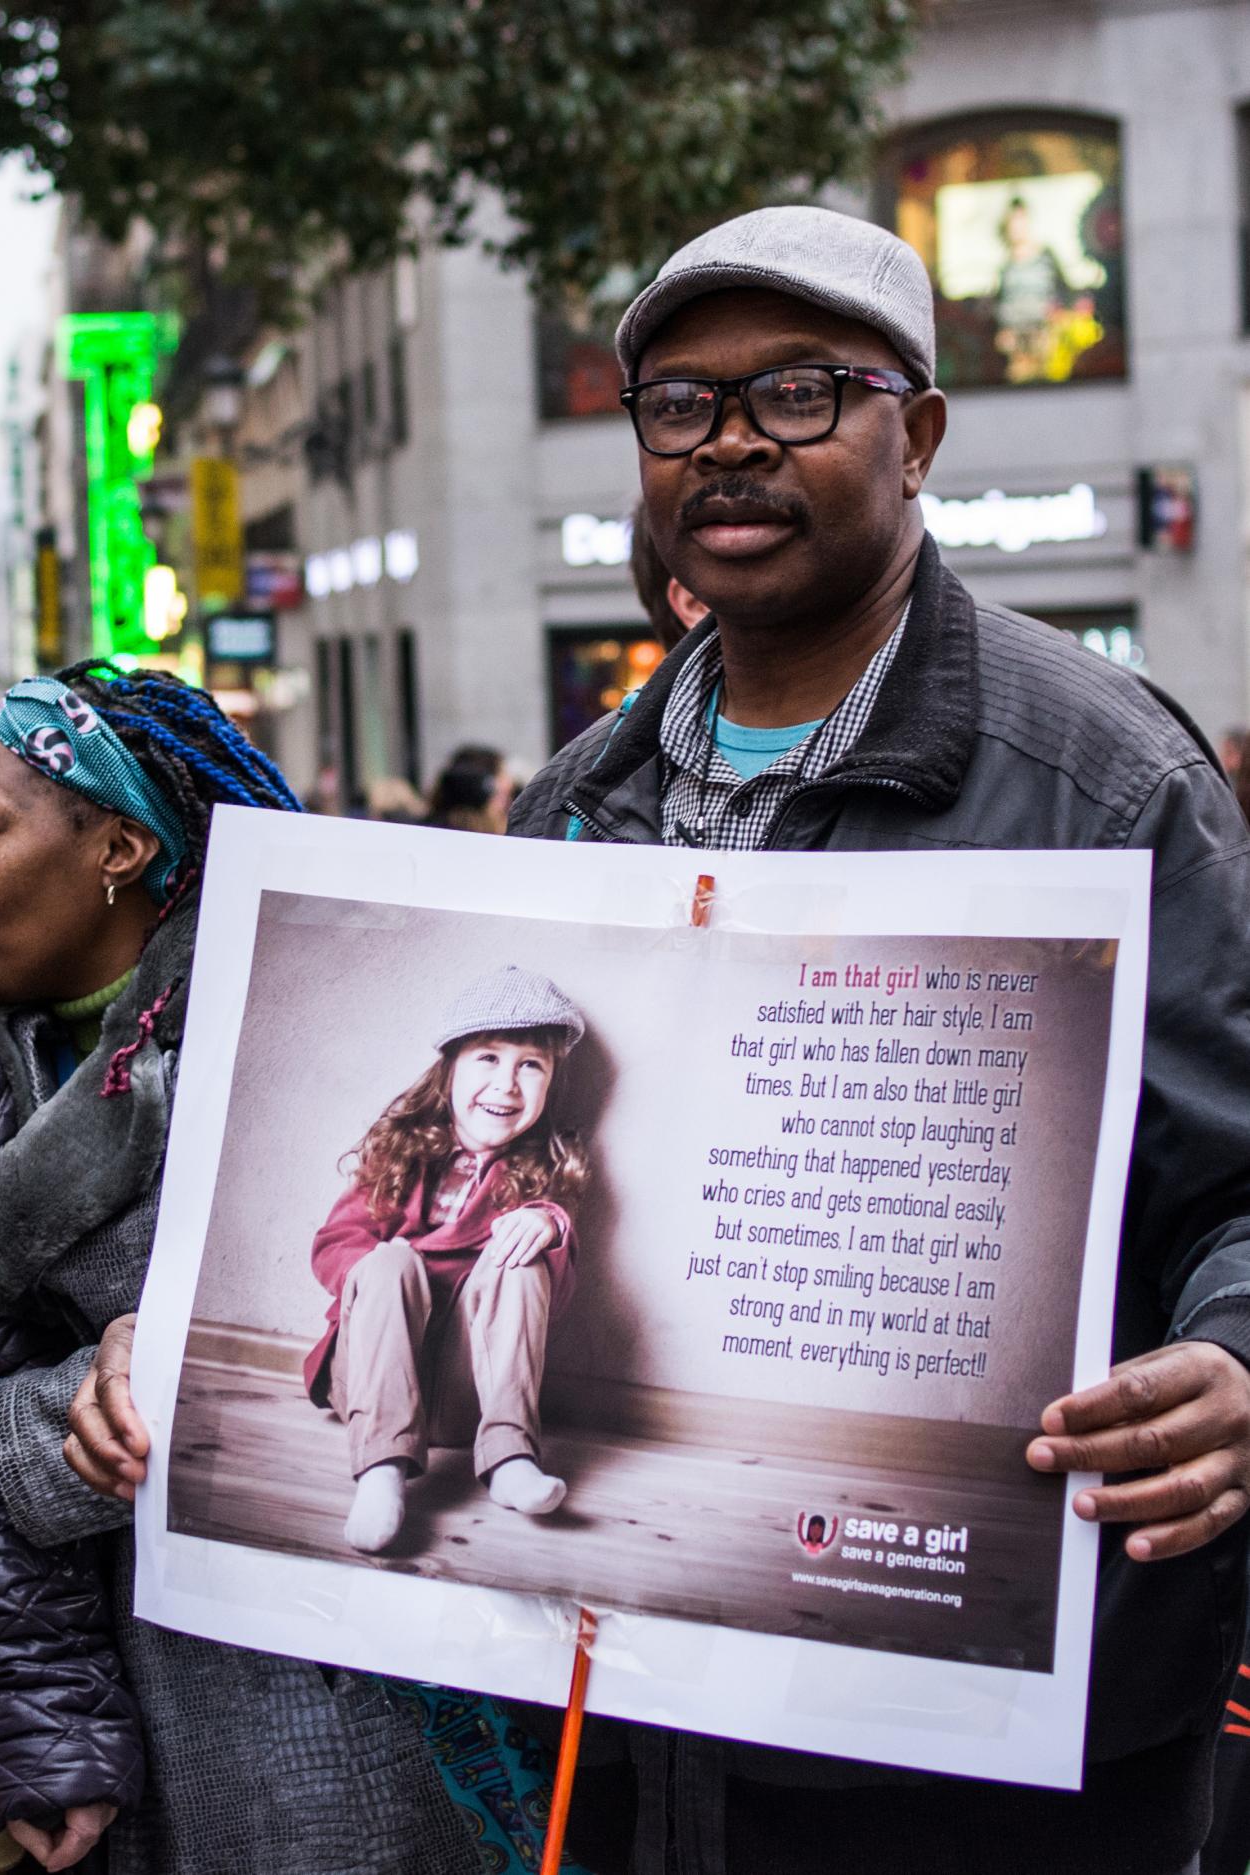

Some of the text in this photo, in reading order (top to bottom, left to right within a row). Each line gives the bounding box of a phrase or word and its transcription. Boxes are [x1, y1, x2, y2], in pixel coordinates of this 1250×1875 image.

[799, 963, 1039, 996] I am that girl who is never
[757, 1000, 1032, 1036] satisfied with her hair style, I am
[731, 1033, 1028, 1076] that girl who has fallen down many
[746, 1072, 1023, 1114] times. But I am also that little girl
[782, 1110, 1017, 1152] who cannot stop laughing at
[709, 1145, 798, 1178] something
[805, 1148, 835, 1173] that
[841, 1149, 922, 1183] happened
[703, 1178, 739, 1203] who
[744, 1184, 786, 1207] cries
[791, 1186, 823, 1210] and
[827, 1189, 862, 1219] gets
[867, 1193, 950, 1219] emotional
[715, 1215, 742, 1240] but
[848, 1225, 855, 1250] I
[859, 1234, 885, 1253] am
[892, 1229, 925, 1255] that
[929, 1232, 959, 1264] girl
[966, 1234, 1001, 1261] who
[686, 1251, 995, 1300] just can't stop smiling because I am
[730, 1294, 990, 1338] strong and in my world at that
[722, 1336, 986, 1379] moment, everything is perfect!!
[844, 1518, 968, 1555] save a girl
[841, 1545, 965, 1574] save a generation
[792, 1572, 962, 1608] www.saveagirlsaveageneration.org
